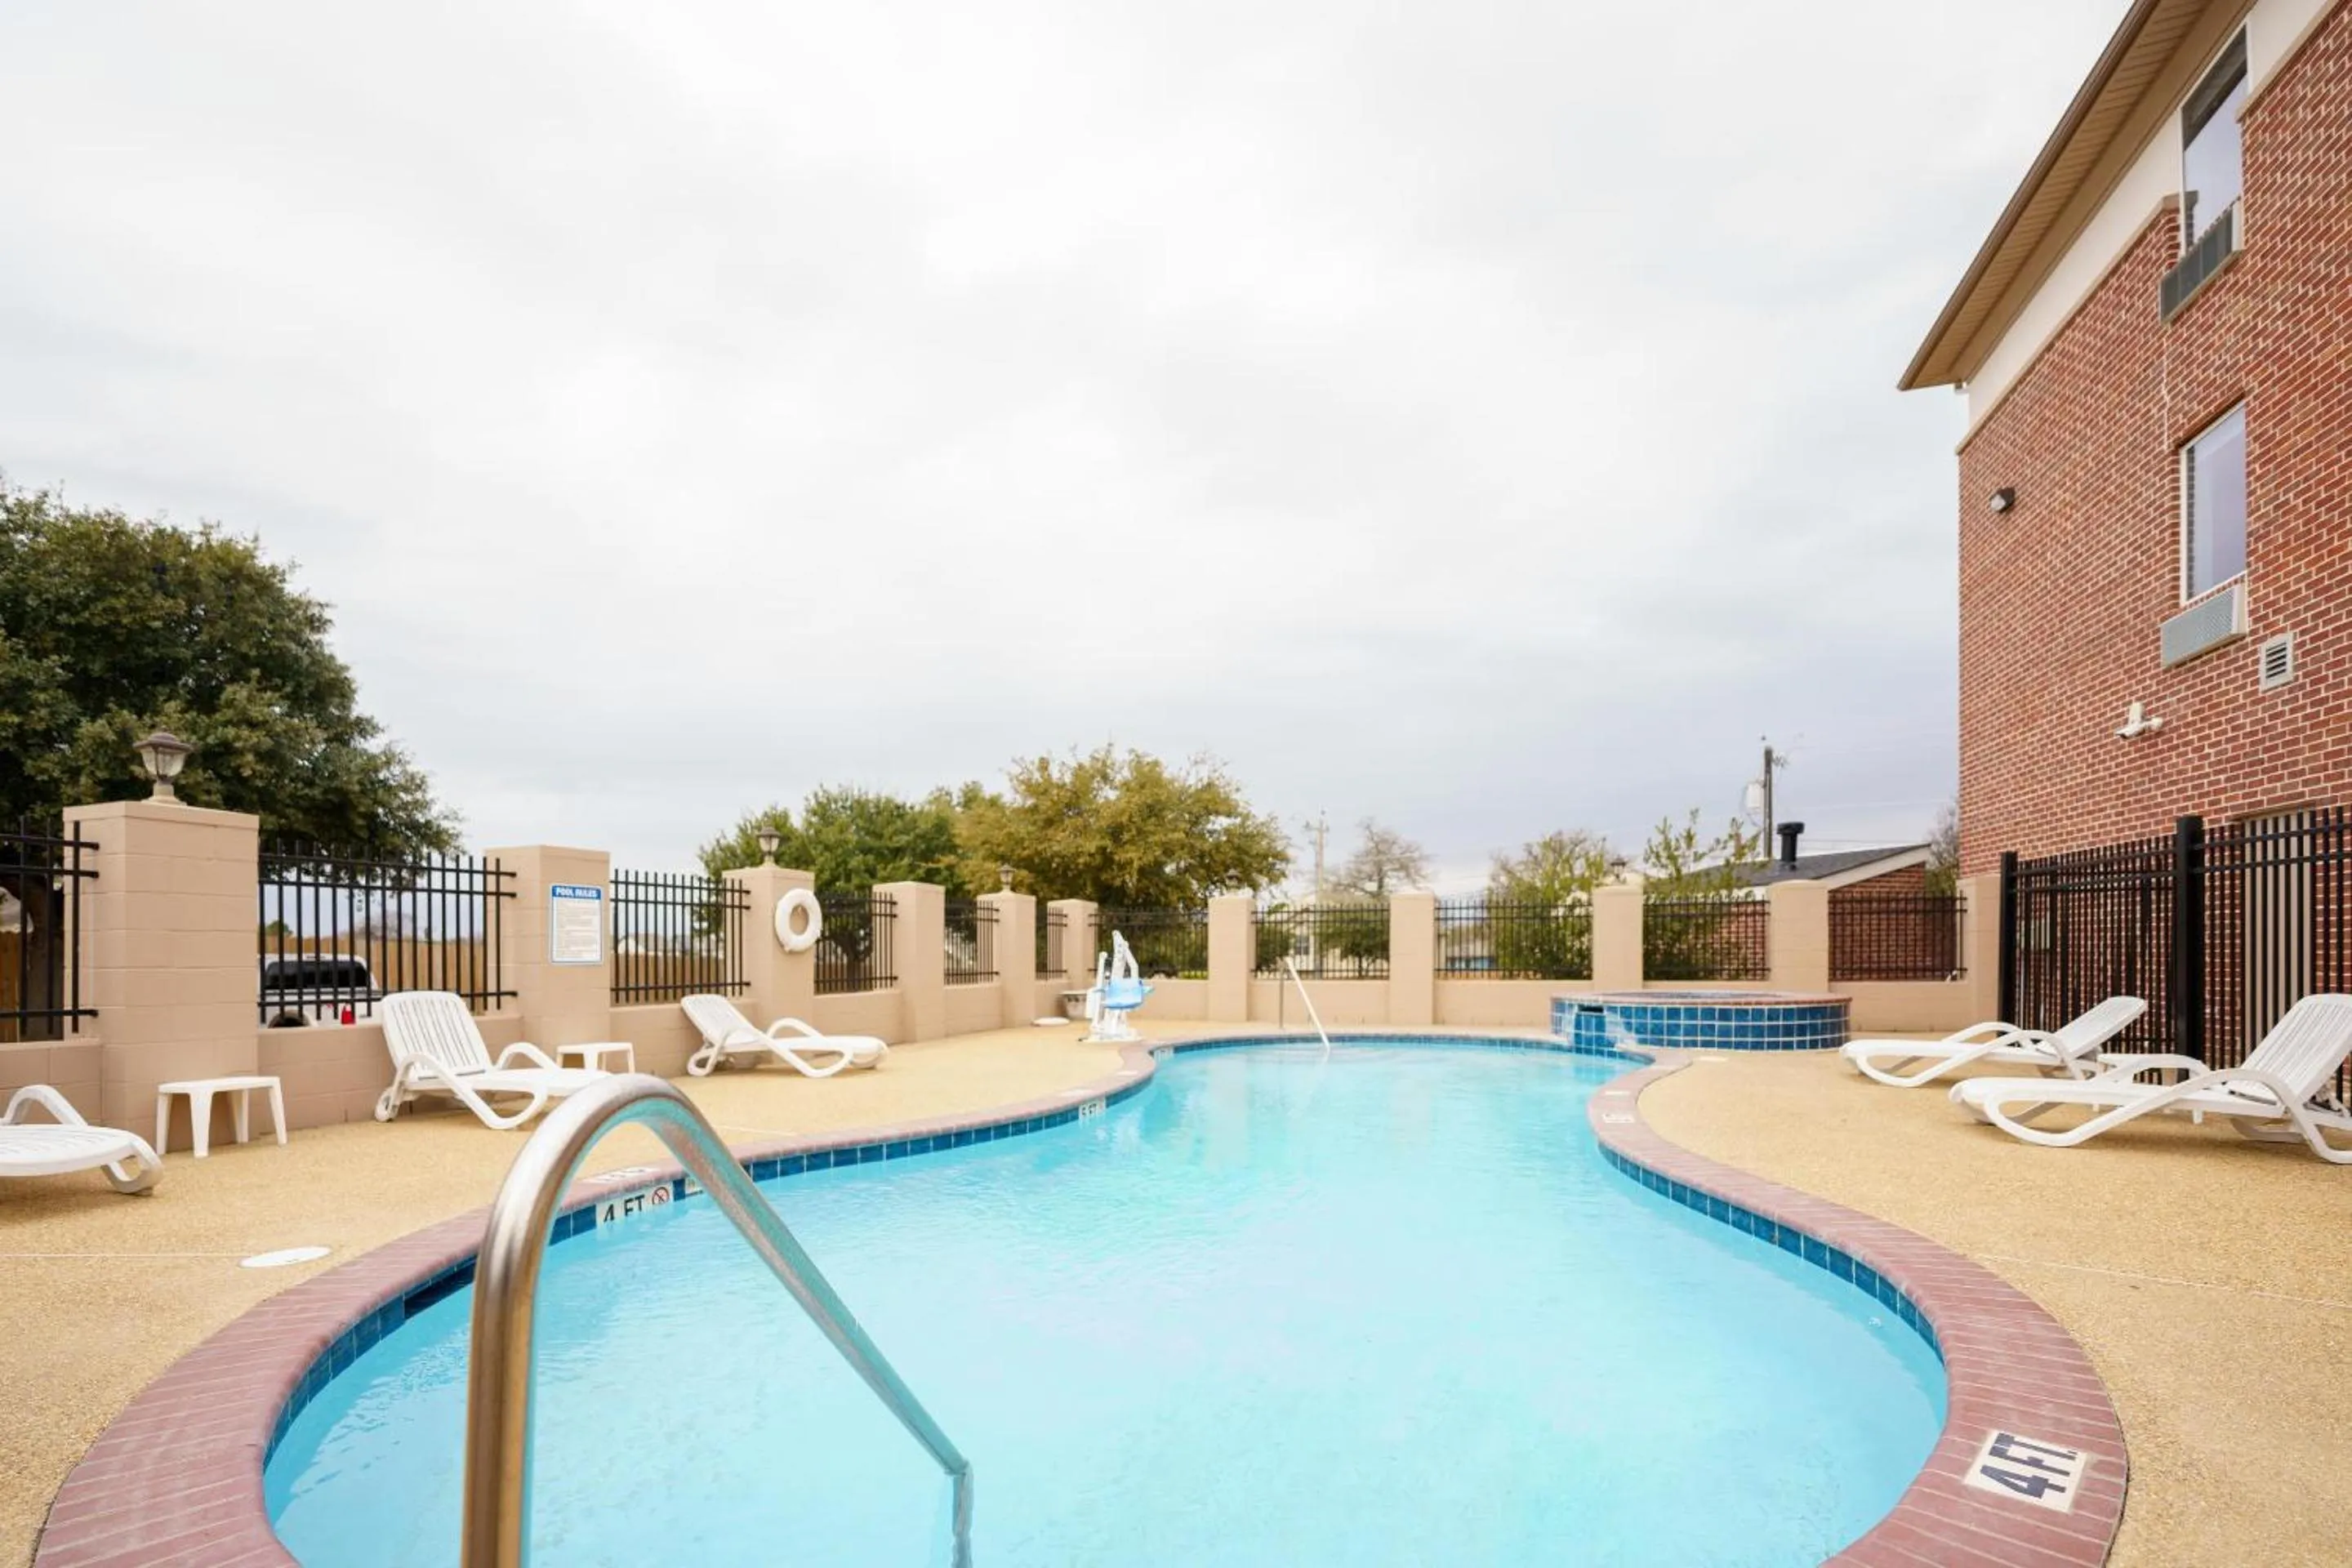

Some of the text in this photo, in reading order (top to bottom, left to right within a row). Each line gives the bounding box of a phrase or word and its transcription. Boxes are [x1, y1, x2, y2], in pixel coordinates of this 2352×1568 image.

[555, 887, 598, 898] POOL RULES
[603, 1194, 645, 1223] 4 FT
